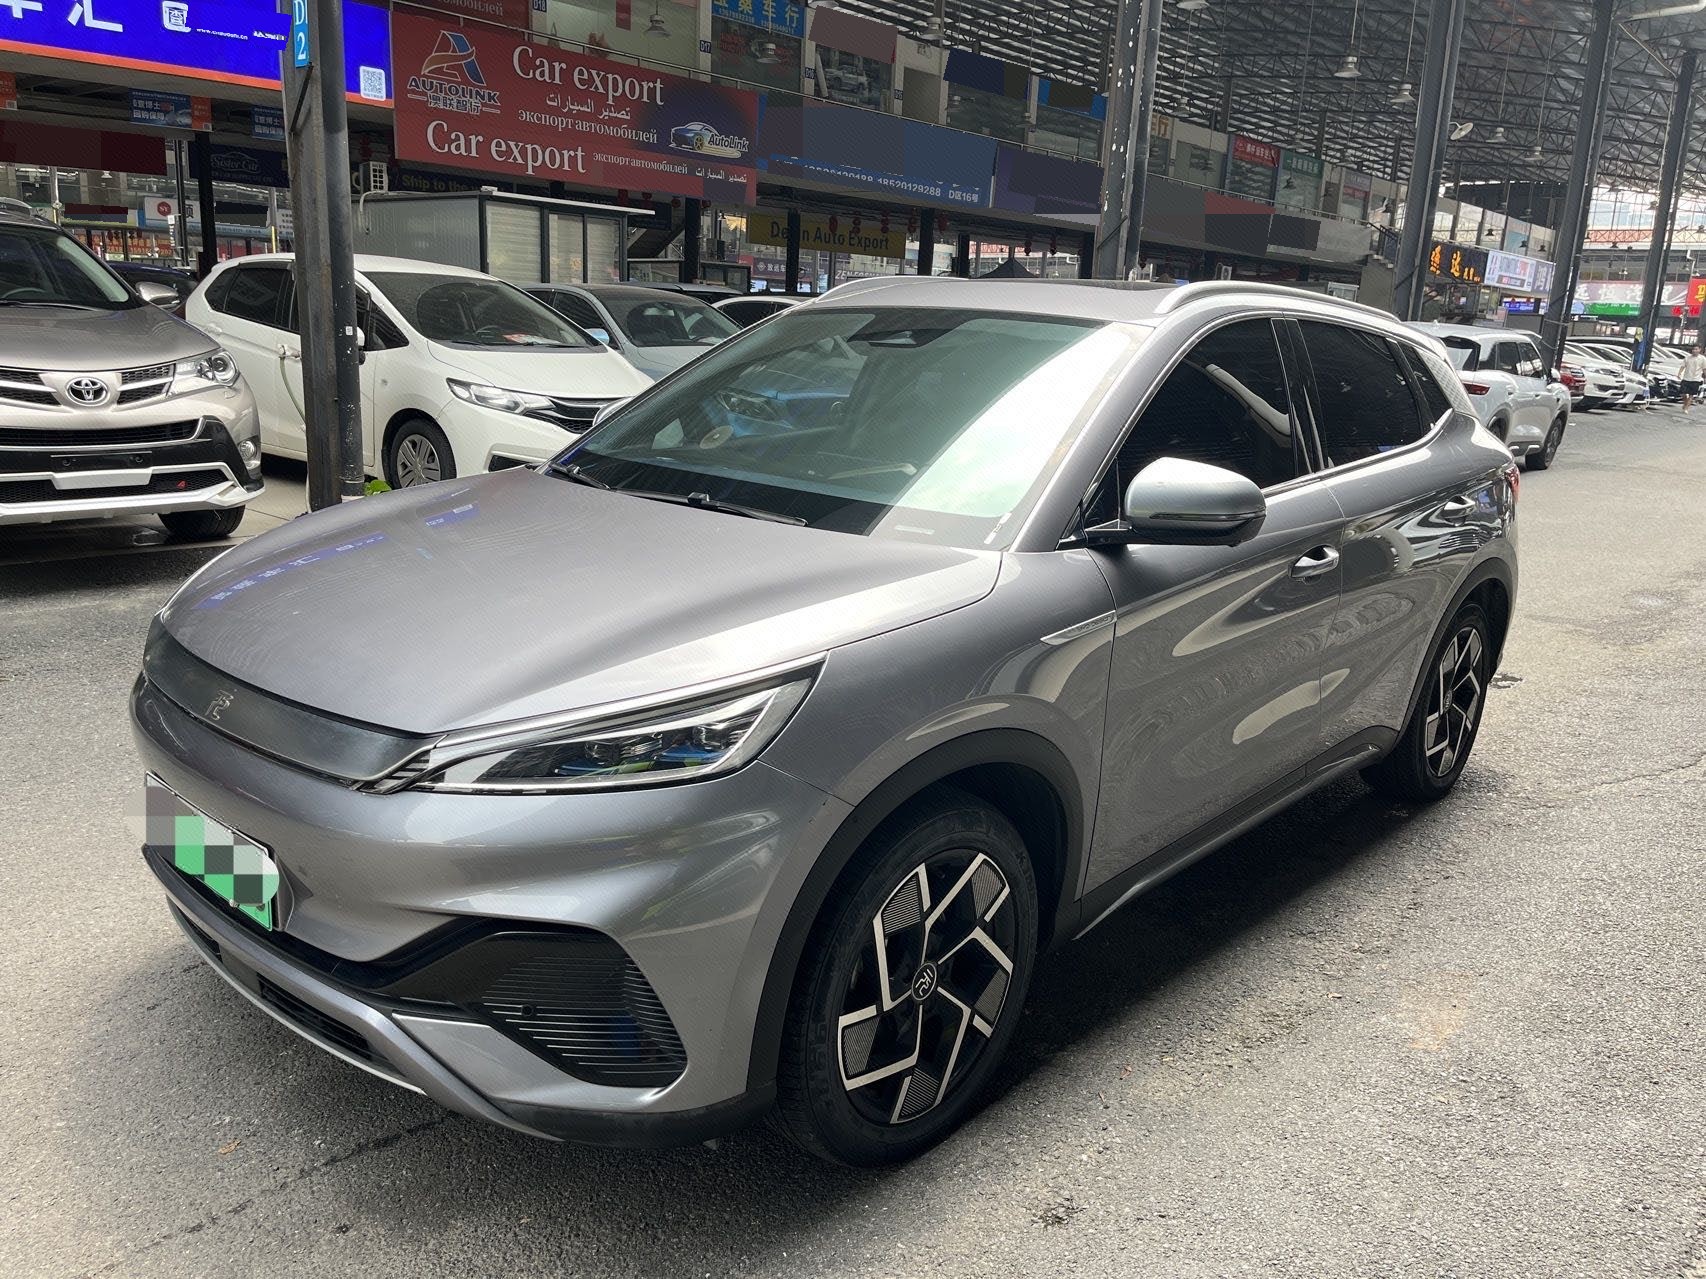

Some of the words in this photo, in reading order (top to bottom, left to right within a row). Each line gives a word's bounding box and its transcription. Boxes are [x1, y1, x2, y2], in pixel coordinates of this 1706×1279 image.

[513, 45, 567, 85] Car
[573, 66, 665, 106] export
[407, 76, 501, 106] AUTOLINK
[546, 93, 594, 113] السيارات
[518, 108, 573, 132] экспорт
[575, 118, 658, 144] автомобилей
[598, 105, 631, 120] تصدير
[427, 120, 483, 158] Car
[491, 137, 586, 175] export
[707, 132, 749, 152] AutoLink
[813, 226, 845, 247] Auto
[849, 230, 890, 251] Export
